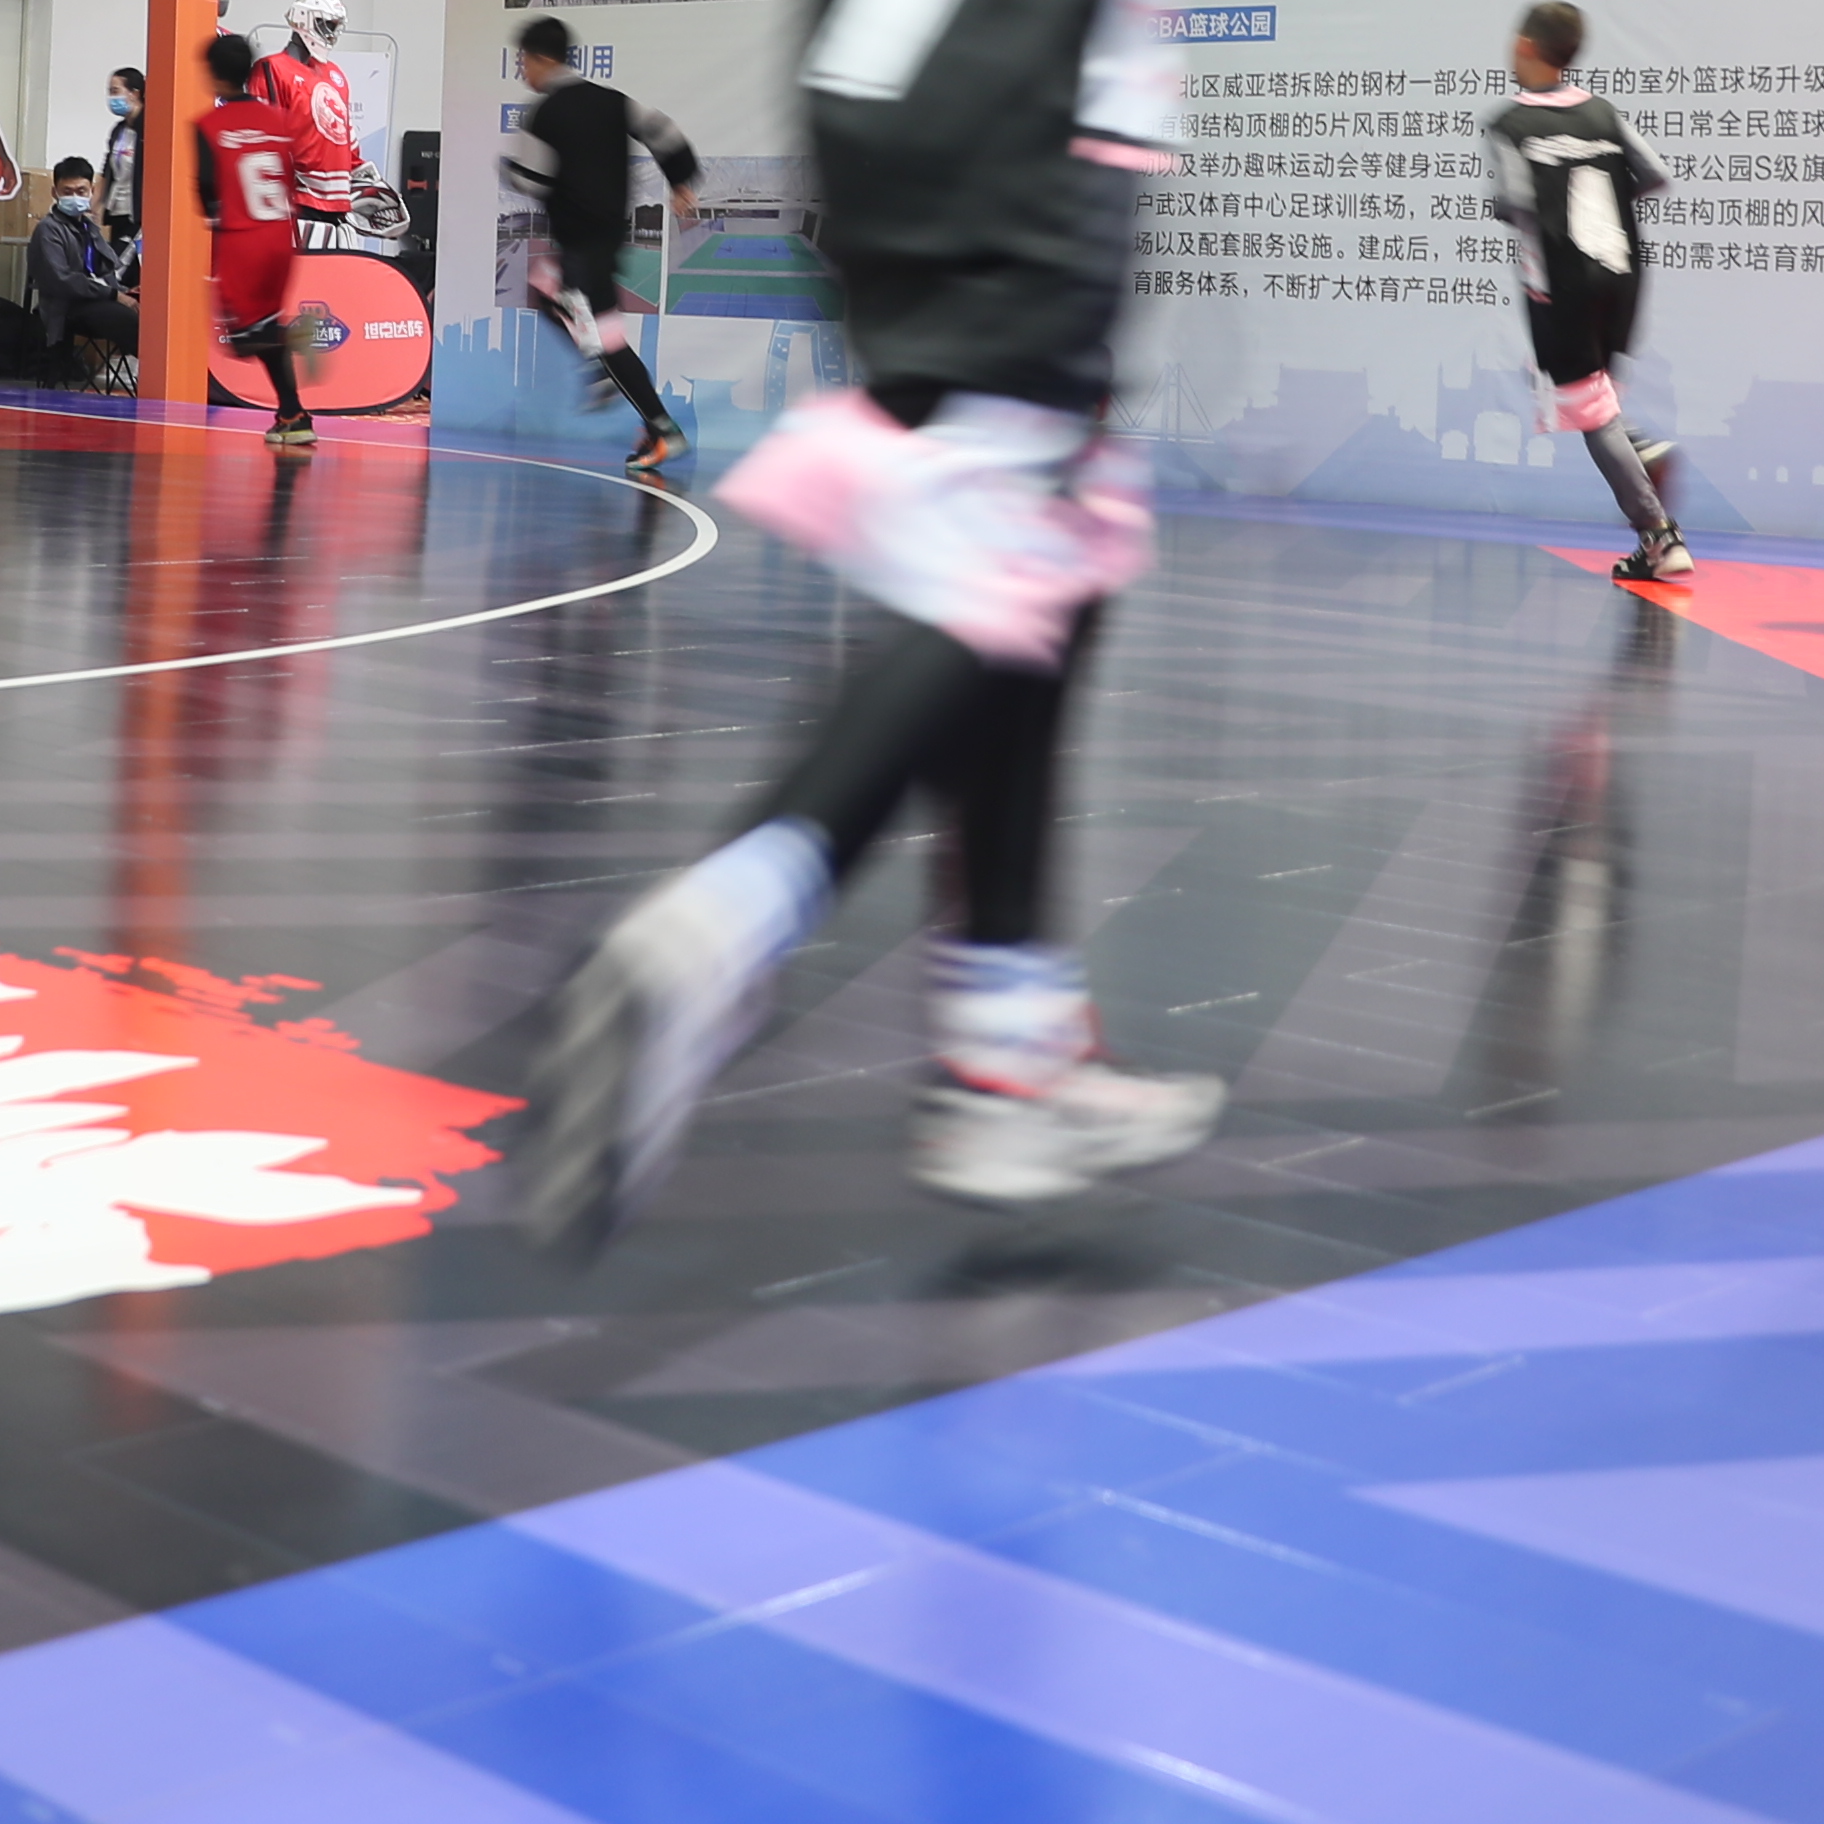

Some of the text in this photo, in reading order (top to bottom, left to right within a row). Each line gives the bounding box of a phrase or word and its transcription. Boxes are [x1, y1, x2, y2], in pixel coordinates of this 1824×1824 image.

[237, 150, 291, 222] 6
[363, 320, 425, 340] 坦克达阵
